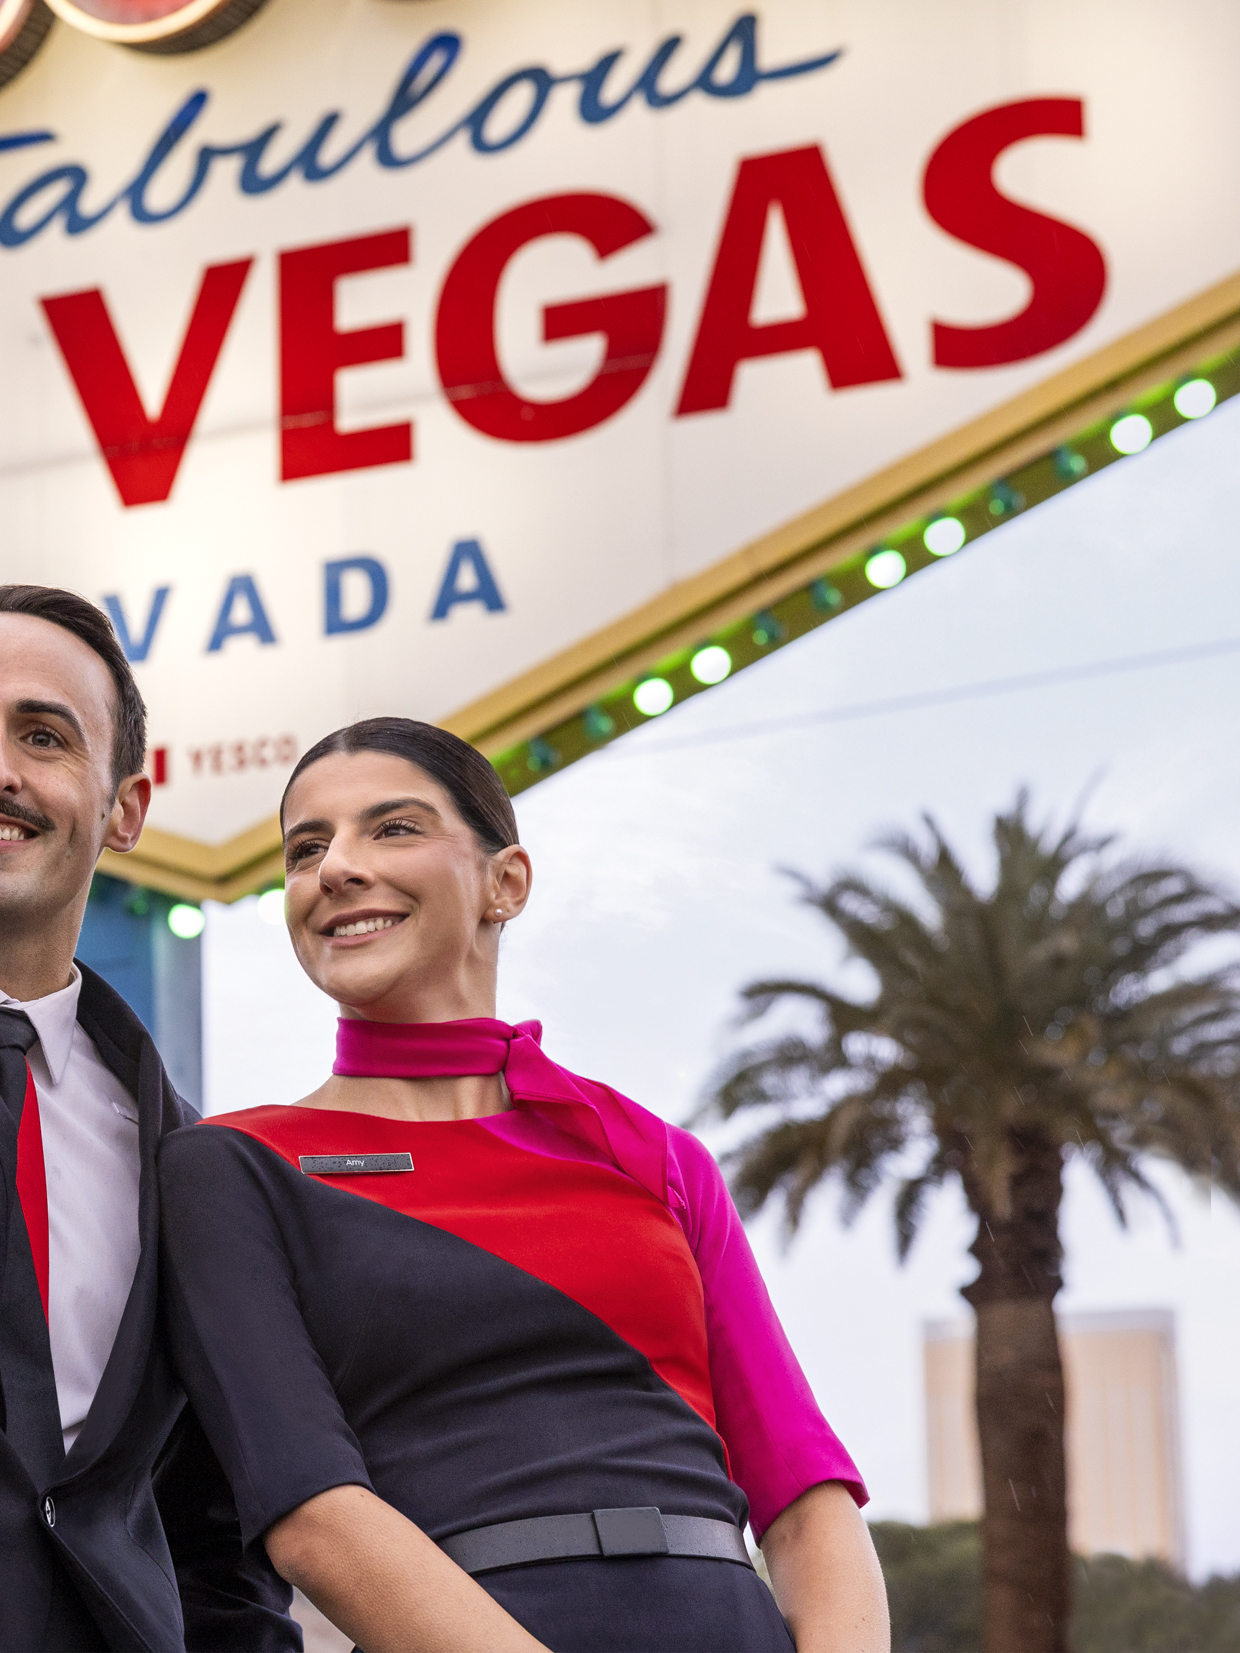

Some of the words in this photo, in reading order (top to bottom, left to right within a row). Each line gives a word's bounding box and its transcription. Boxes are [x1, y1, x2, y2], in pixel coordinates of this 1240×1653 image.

[38, 94, 1109, 508] VEGAS
[189, 735, 298, 776] YESCO
[345, 1158, 365, 1167] Amy
